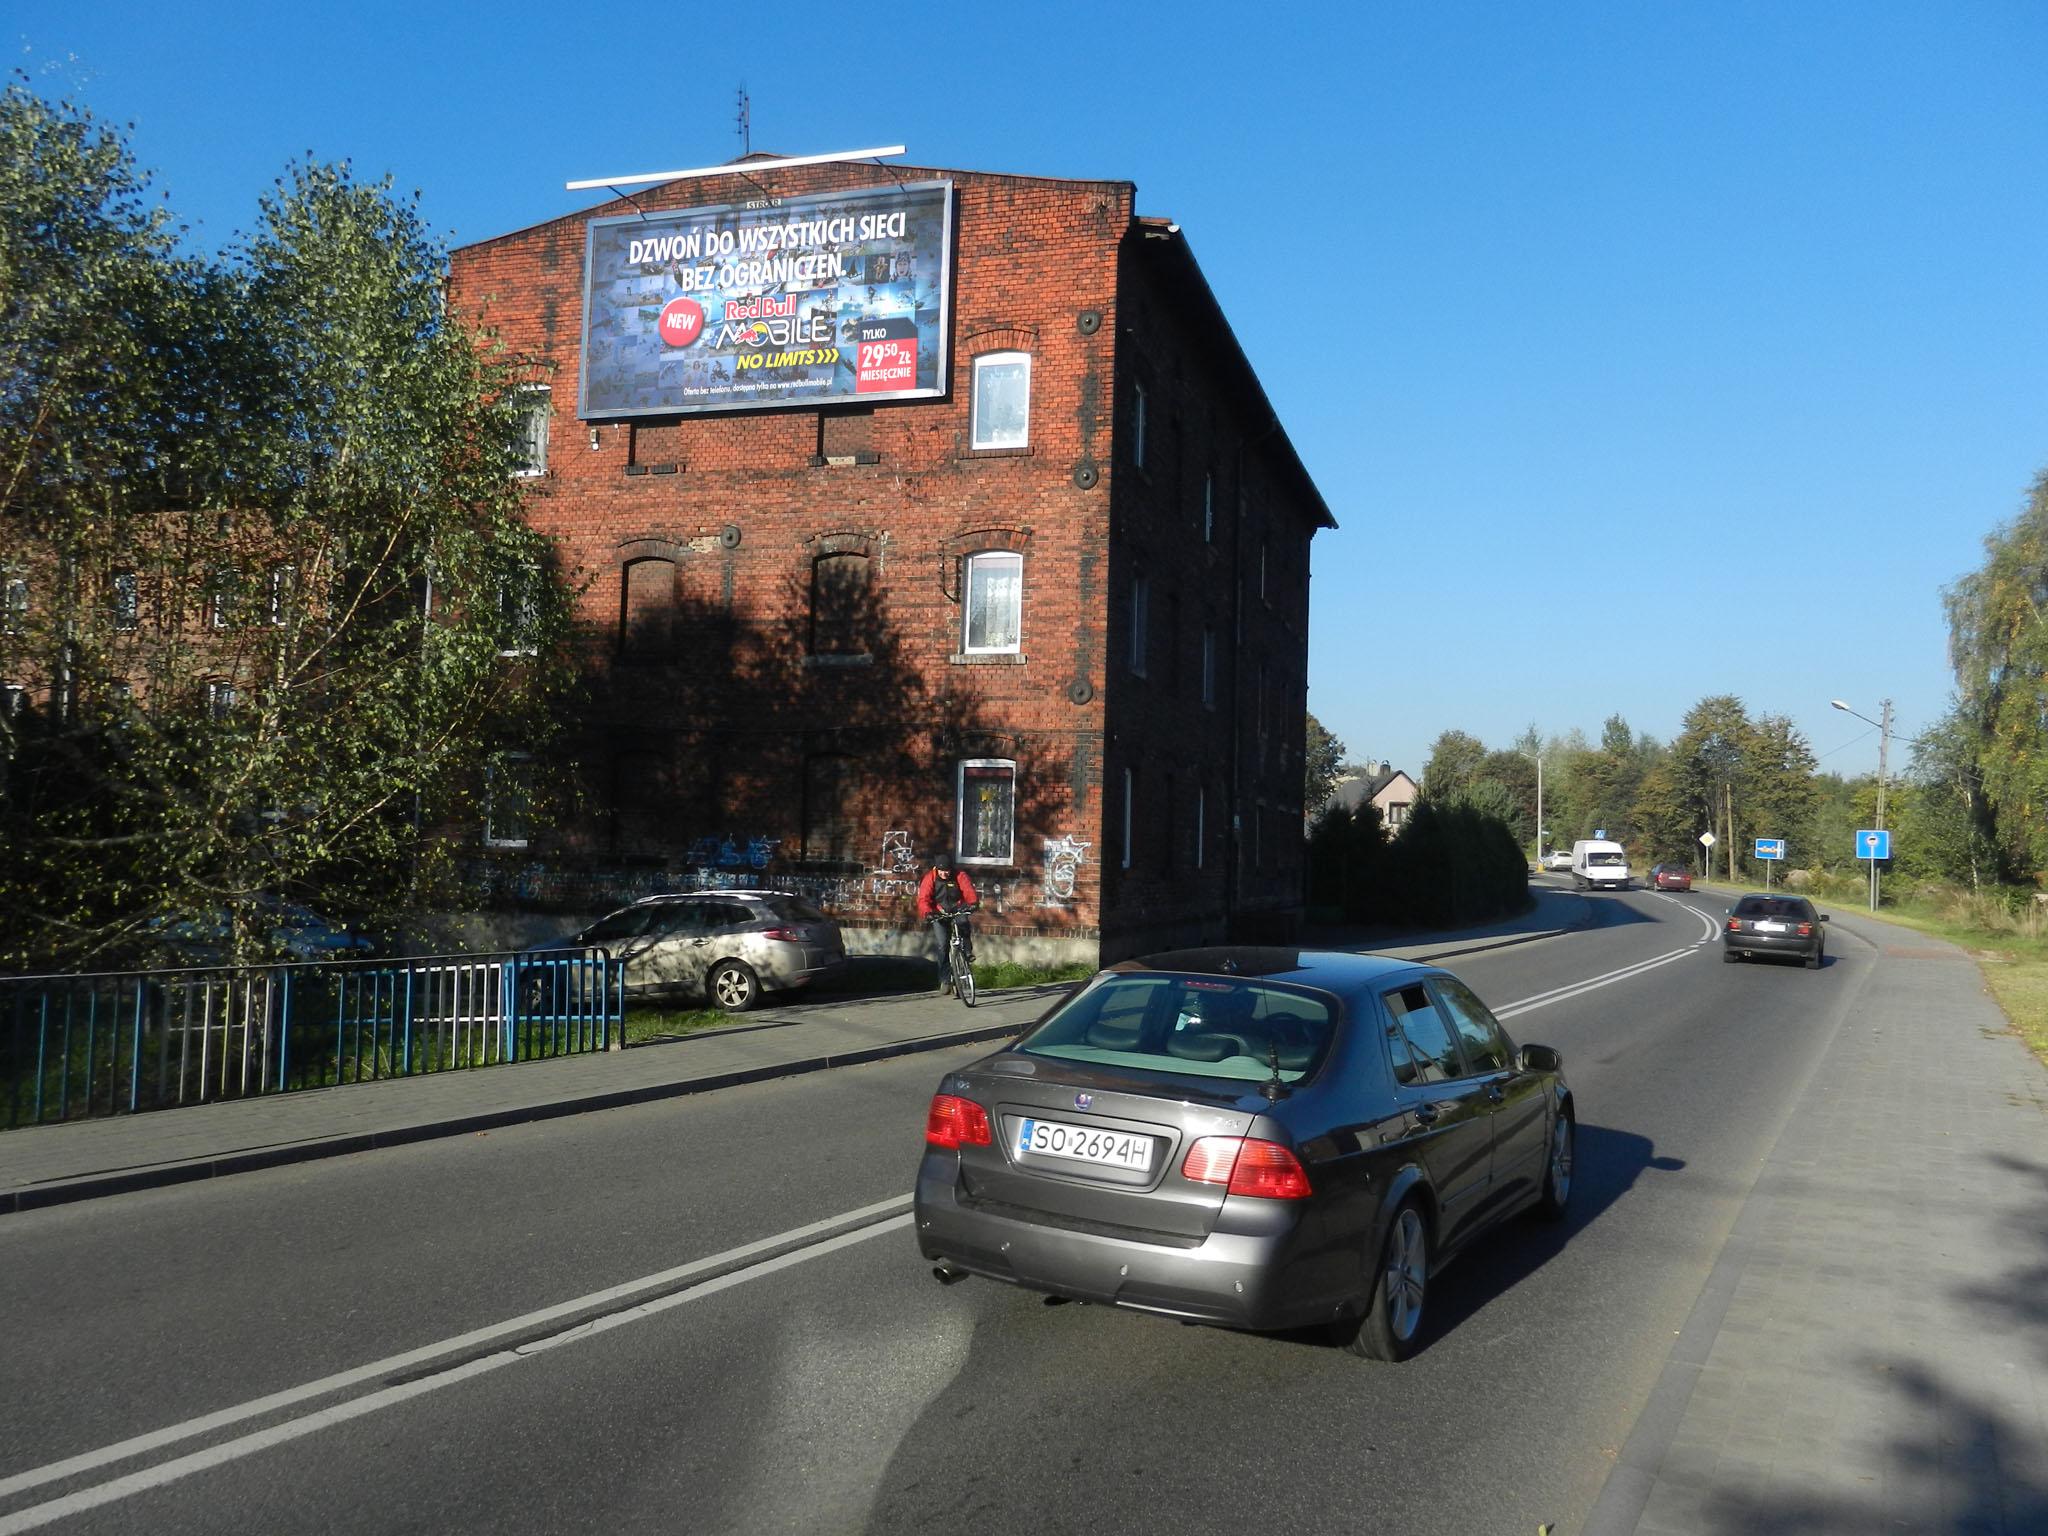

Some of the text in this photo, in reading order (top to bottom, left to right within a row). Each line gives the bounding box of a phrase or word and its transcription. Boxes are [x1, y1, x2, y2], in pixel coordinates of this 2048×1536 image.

[629, 211, 906, 264] DZWOŃ DO WSZYSTKICH SIECI
[682, 246, 847, 291] BEZ OGRANICZEŃ.
[725, 294, 797, 321] Red Bull
[666, 312, 696, 330] NEW
[715, 315, 831, 350] MOBILE
[862, 328, 887, 340] TYLKO
[736, 350, 815, 370] NO LIMITS
[898, 350, 912, 365] ZŁ
[860, 367, 912, 382] MIESIĘCZNIE
[1034, 1126, 1147, 1165] SO 2694H
